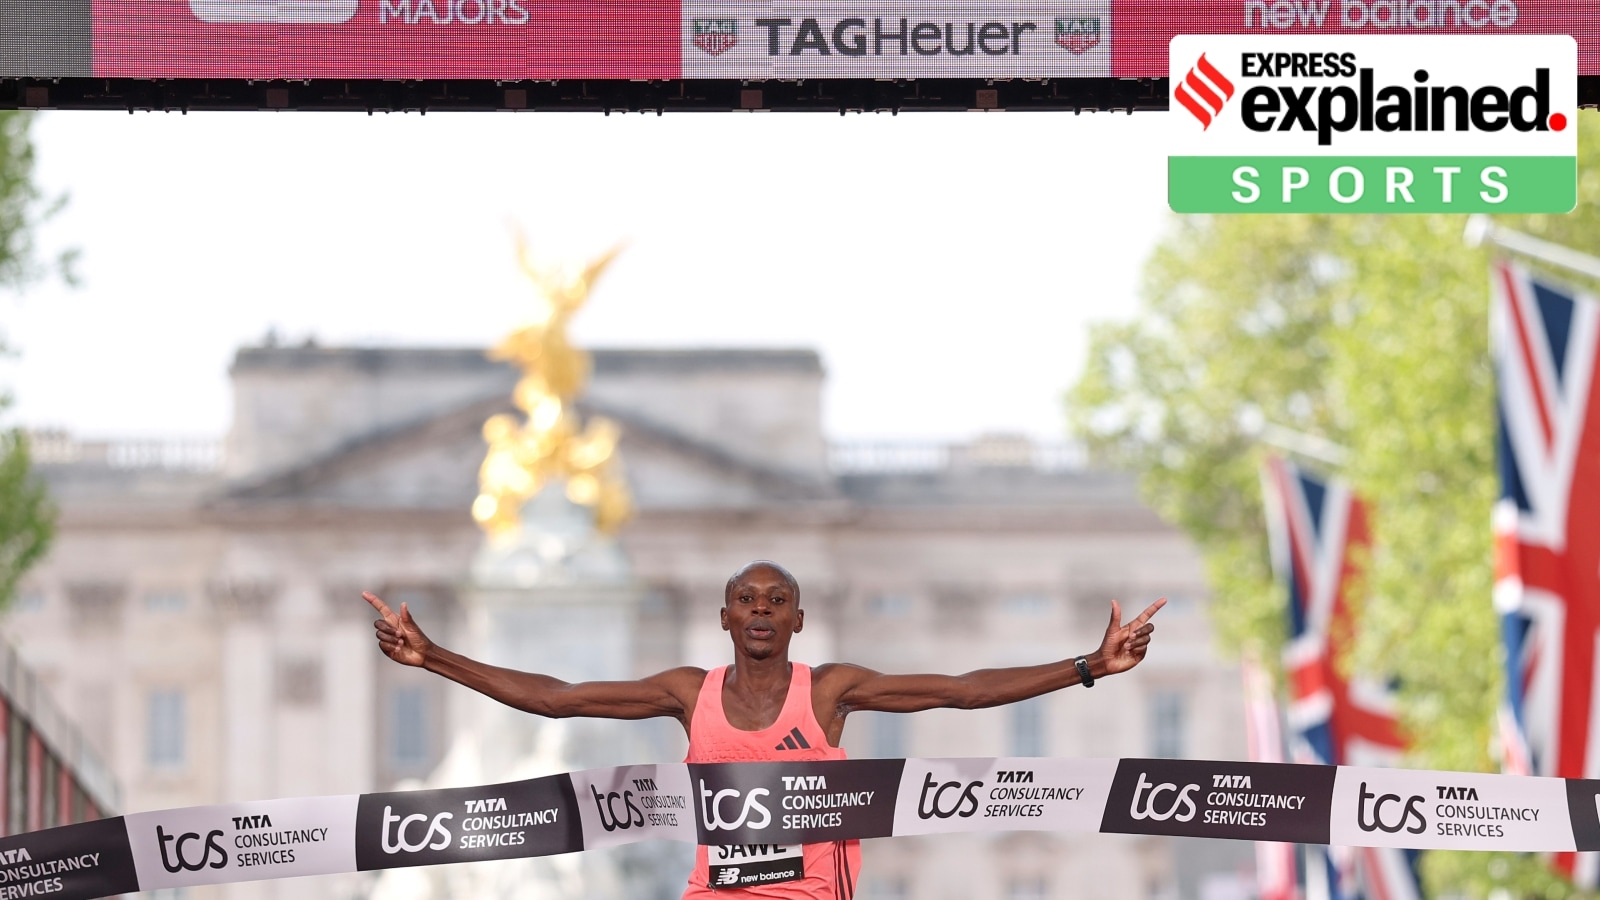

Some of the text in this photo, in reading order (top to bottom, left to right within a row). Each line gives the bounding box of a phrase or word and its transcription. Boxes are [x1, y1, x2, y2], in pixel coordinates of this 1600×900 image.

[378, 0, 531, 25] MAJORS
[1244, 0, 1518, 28] new balance
[632, 779, 658, 792] TATA
[782, 776, 827, 791] TATA
[996, 771, 1034, 783] TATA
[1212, 774, 1251, 789] TATA
[641, 795, 686, 809] CONSULTANCY
[782, 791, 875, 810] CONSULTANCY
[918, 772, 984, 819] tcs
[989, 787, 1084, 800] CONSULTANCY
[1130, 772, 1201, 822] tcs
[1206, 791, 1305, 810] CONSULTANCY
[1436, 785, 1479, 801] TATA
[464, 798, 507, 813] TATA
[590, 784, 645, 832] tcs
[700, 778, 772, 831] tcs
[984, 804, 1044, 817] SERVICES
[1358, 781, 1427, 834] tcs
[1435, 804, 1539, 822] CONSULTANCY
[232, 815, 272, 830] TATA
[462, 808, 559, 831] CONSULTANCY
[648, 813, 678, 827] SERVICES
[782, 812, 842, 830] SERVICES
[1203, 810, 1267, 826] SERVICES
[235, 828, 328, 848] CONSULTANCY
[381, 805, 453, 854] tcs
[1436, 822, 1504, 838] SERVICES
[156, 825, 228, 873] tcs
[460, 831, 525, 849] SERVICES
[0, 847, 32, 866] ATA
[237, 849, 295, 867] SERVICES
[0, 852, 100, 883] ONSULTANCY
[741, 873, 759, 883] new
[759, 869, 795, 881] balance
[0, 877, 63, 900] ERVICES
